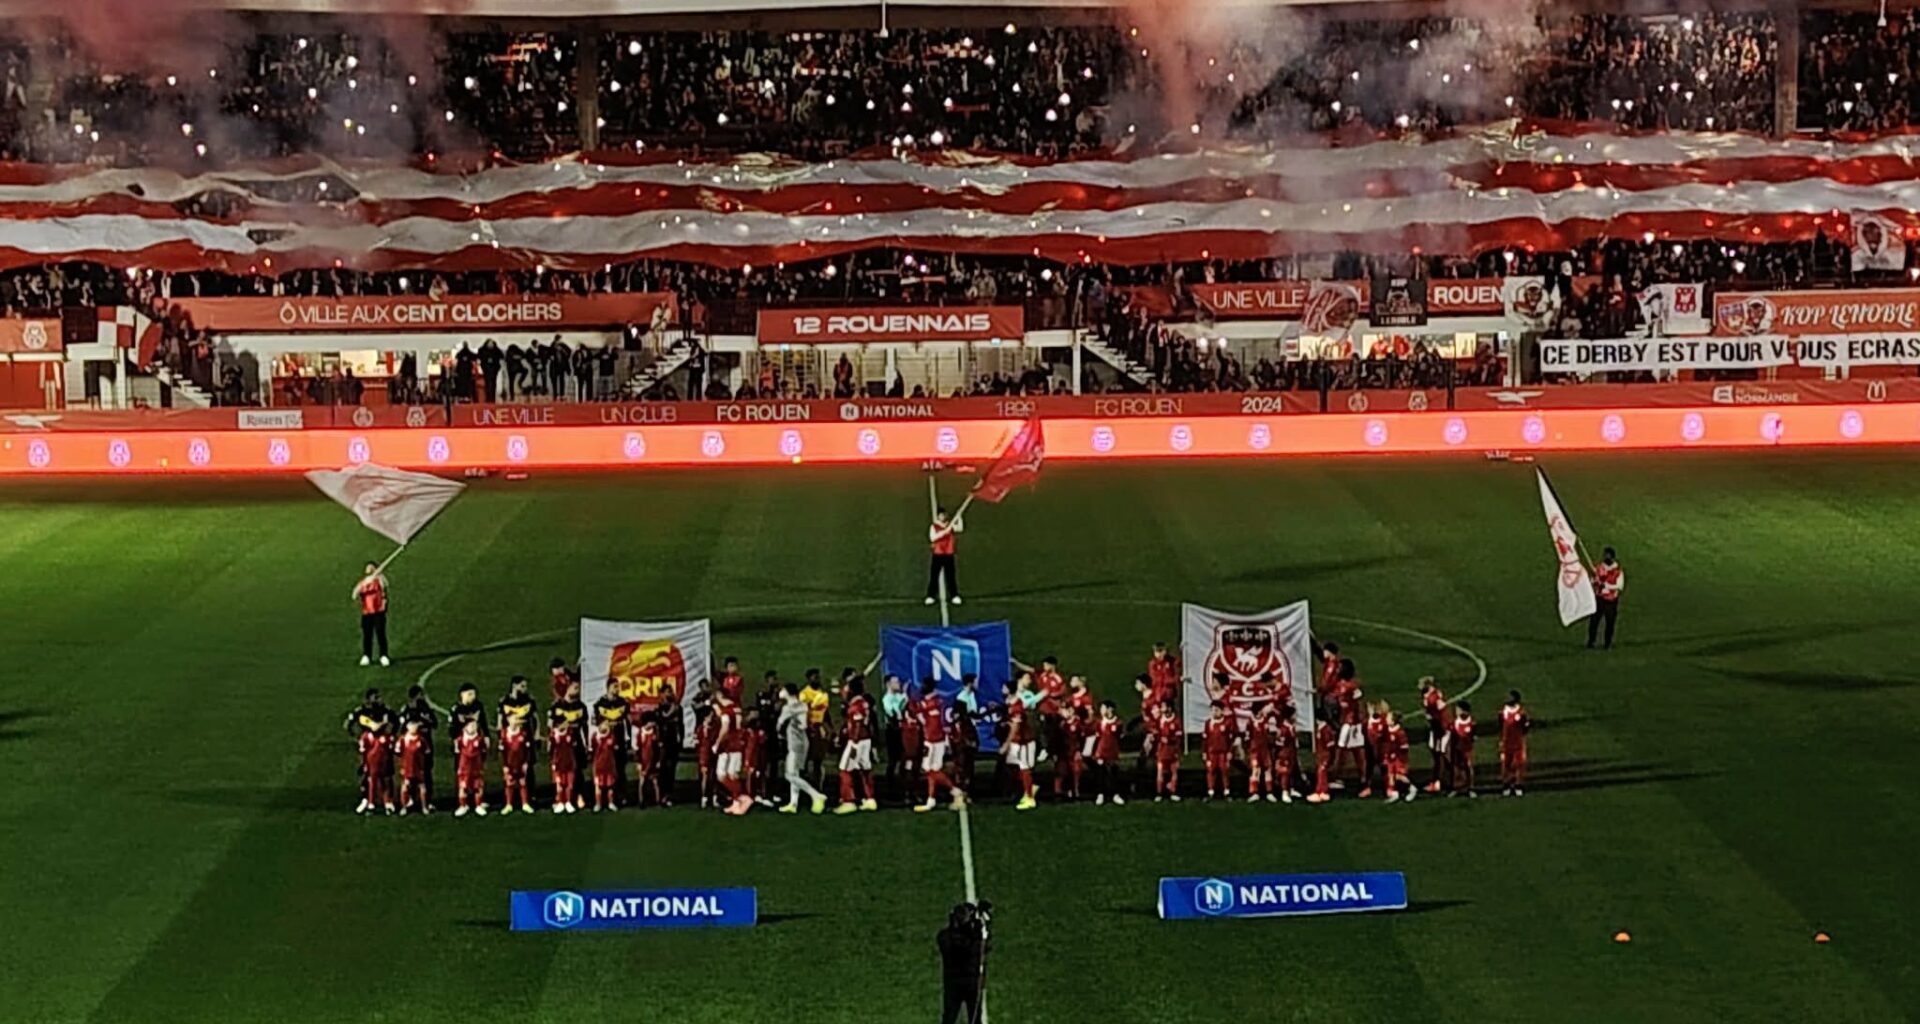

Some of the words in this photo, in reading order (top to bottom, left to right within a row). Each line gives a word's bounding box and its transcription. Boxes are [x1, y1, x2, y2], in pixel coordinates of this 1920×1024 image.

[1213, 291, 1253, 308] UNE
[1255, 289, 1305, 307] VILLE
[1434, 286, 1504, 305] ROUEN
[299, 307, 348, 324] VILLE
[351, 306, 390, 323] AUX
[393, 304, 448, 323] CENT
[451, 303, 562, 322] CLOCHERS
[1780, 305, 1825, 326] KOP
[793, 316, 821, 334] 12
[827, 314, 991, 333] ROUENNAIS
[1543, 345, 1570, 365] CE
[1576, 343, 1648, 364] DERBY
[1658, 342, 1699, 362] EST
[1706, 341, 1763, 362] POUR
[1849, 338, 1920, 359] ECRAS
[600, 407, 627, 423] UN
[629, 406, 677, 422] CLUB
[717, 405, 741, 421] FC
[745, 404, 810, 420] ROUEN
[863, 405, 935, 417] NATIONAL
[1095, 399, 1118, 416] FC
[1121, 398, 1183, 415] ROUEN
[1241, 397, 1282, 413] 2024
[473, 408, 509, 425] UNE
[512, 407, 554, 424] VILLE
[931, 648, 962, 681] N
[617, 675, 677, 700] QRM
[1205, 885, 1224, 904] N
[1240, 882, 1374, 905] NATIONAL
[554, 897, 573, 917] N
[590, 895, 724, 918] NATIONAL
